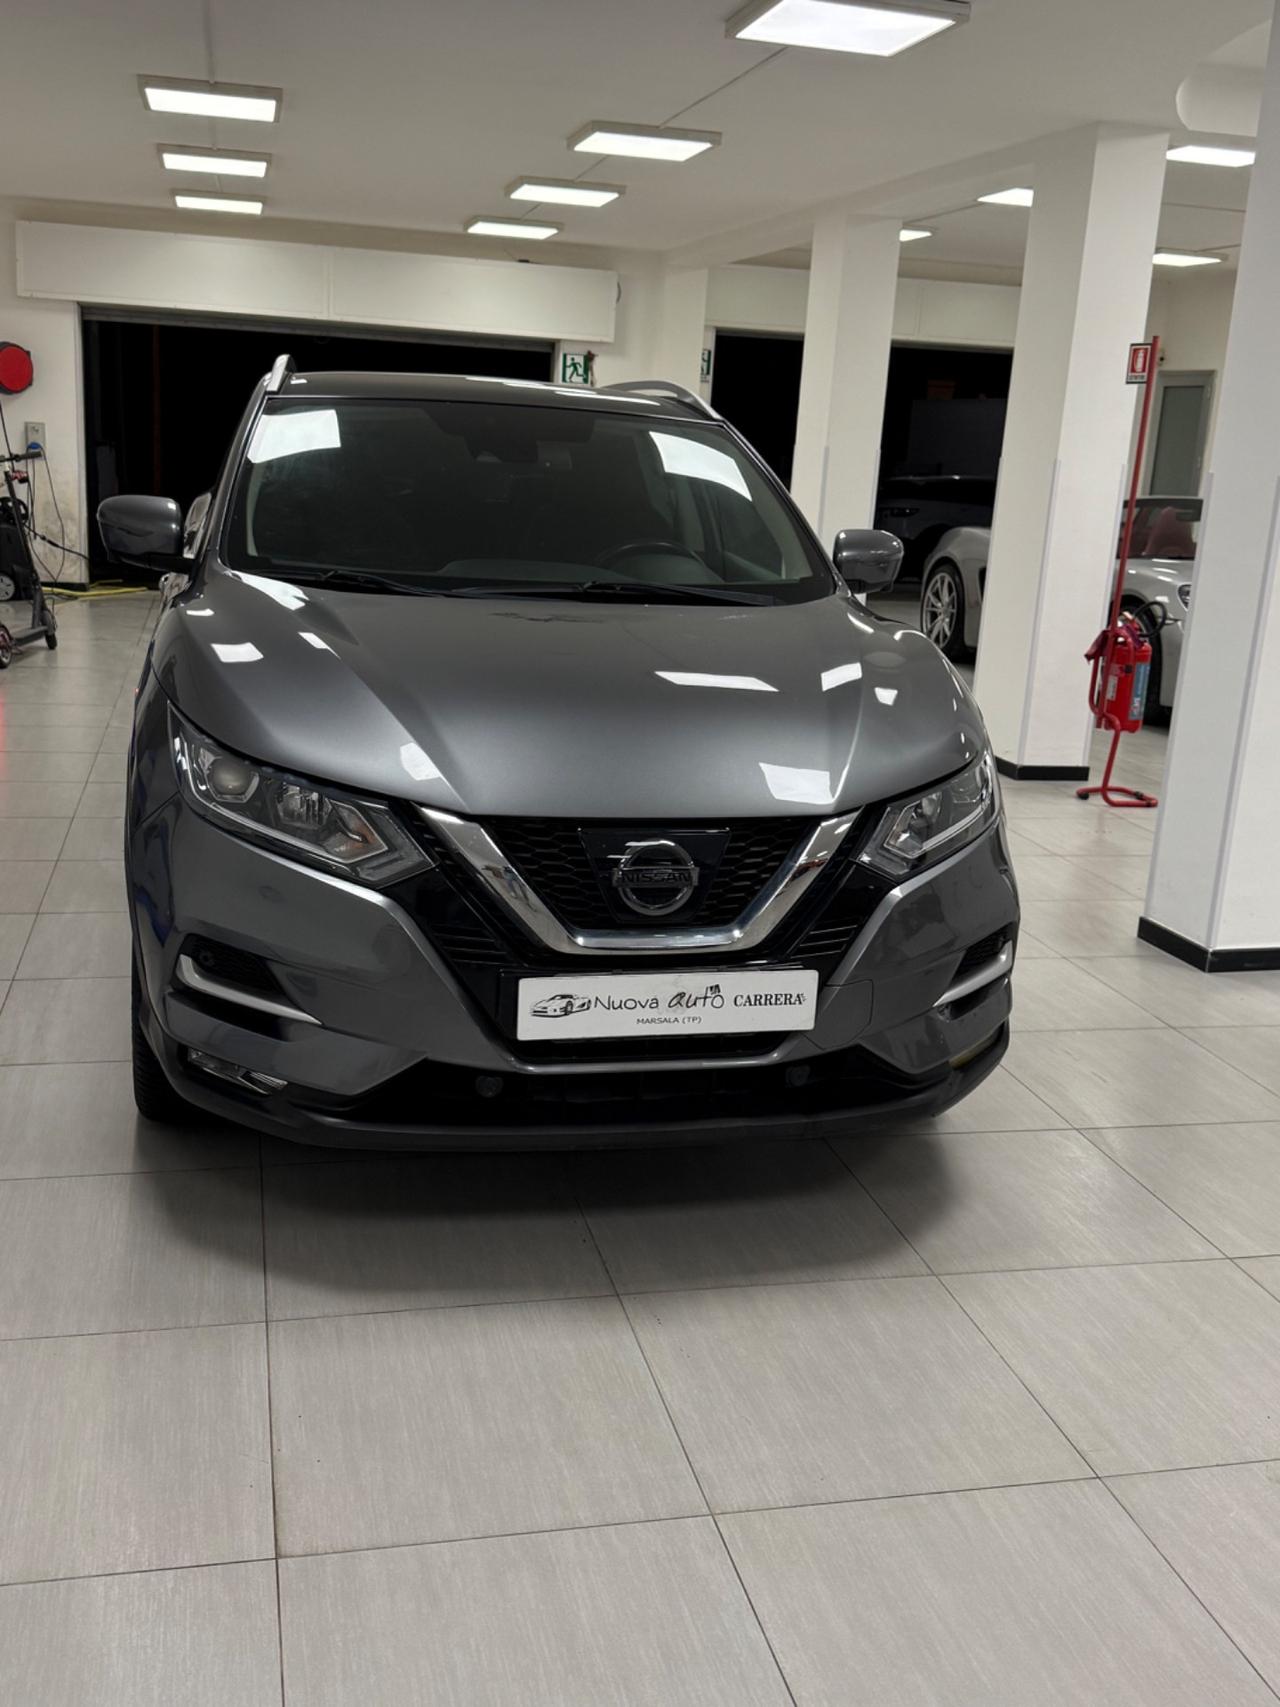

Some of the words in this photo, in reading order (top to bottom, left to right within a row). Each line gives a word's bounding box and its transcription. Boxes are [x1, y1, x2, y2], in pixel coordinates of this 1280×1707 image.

[622, 871, 690, 882] NISSAN
[594, 995, 659, 1011] Nuova
[733, 992, 804, 1008] CARRERA
[636, 1016, 680, 1025] MARSALA
[681, 1015, 702, 1026] (TP)
